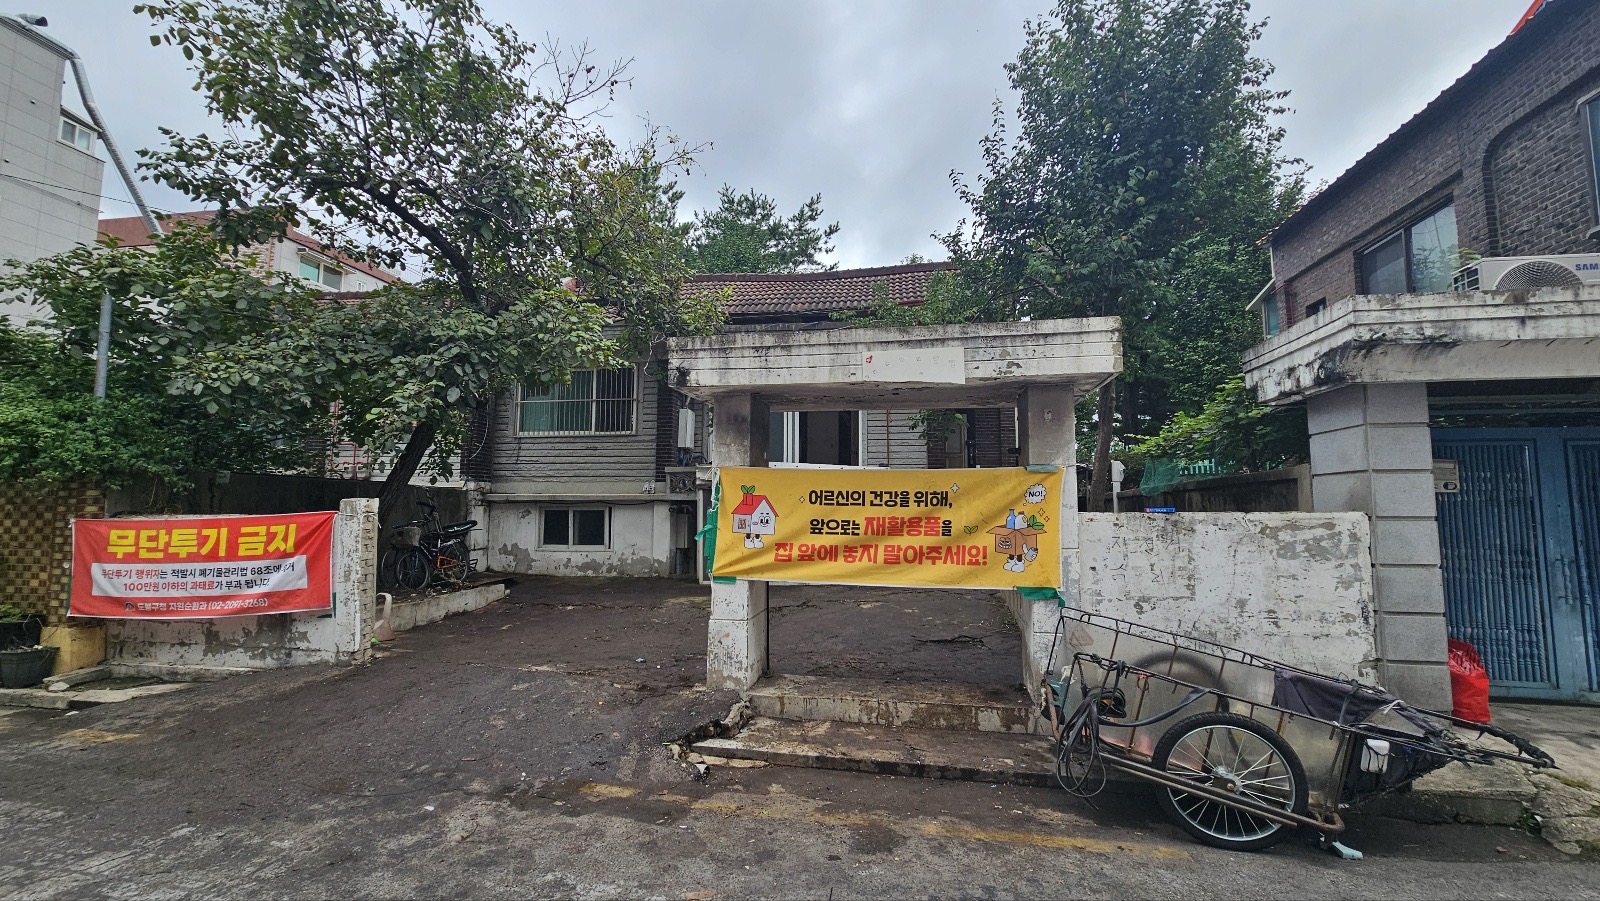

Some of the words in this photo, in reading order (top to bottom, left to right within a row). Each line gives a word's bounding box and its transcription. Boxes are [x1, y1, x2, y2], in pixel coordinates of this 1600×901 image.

[808, 490, 866, 507] 어르신의
[869, 490, 910, 508] 건강을
[913, 490, 953, 509] 위해,
[1028, 490, 1043, 498] NO!
[809, 518, 861, 537] 앞으로는
[863, 515, 952, 537] 재활용품을
[107, 527, 227, 559] 무단투기
[237, 523, 297, 556] 금지
[773, 542, 794, 563] 집
[797, 543, 839, 563] 앞에
[842, 543, 879, 564] 놓지
[883, 544, 988, 566] 말아주세요!
[135, 567, 168, 580] 행위자는
[170, 567, 196, 580] 적발시
[198, 566, 249, 579] 폐기물관리법
[123, 582, 160, 593] 100만원
[161, 580, 189, 593] 이하의
[190, 578, 224, 593] 과태료가
[225, 579, 243, 591] 부과
